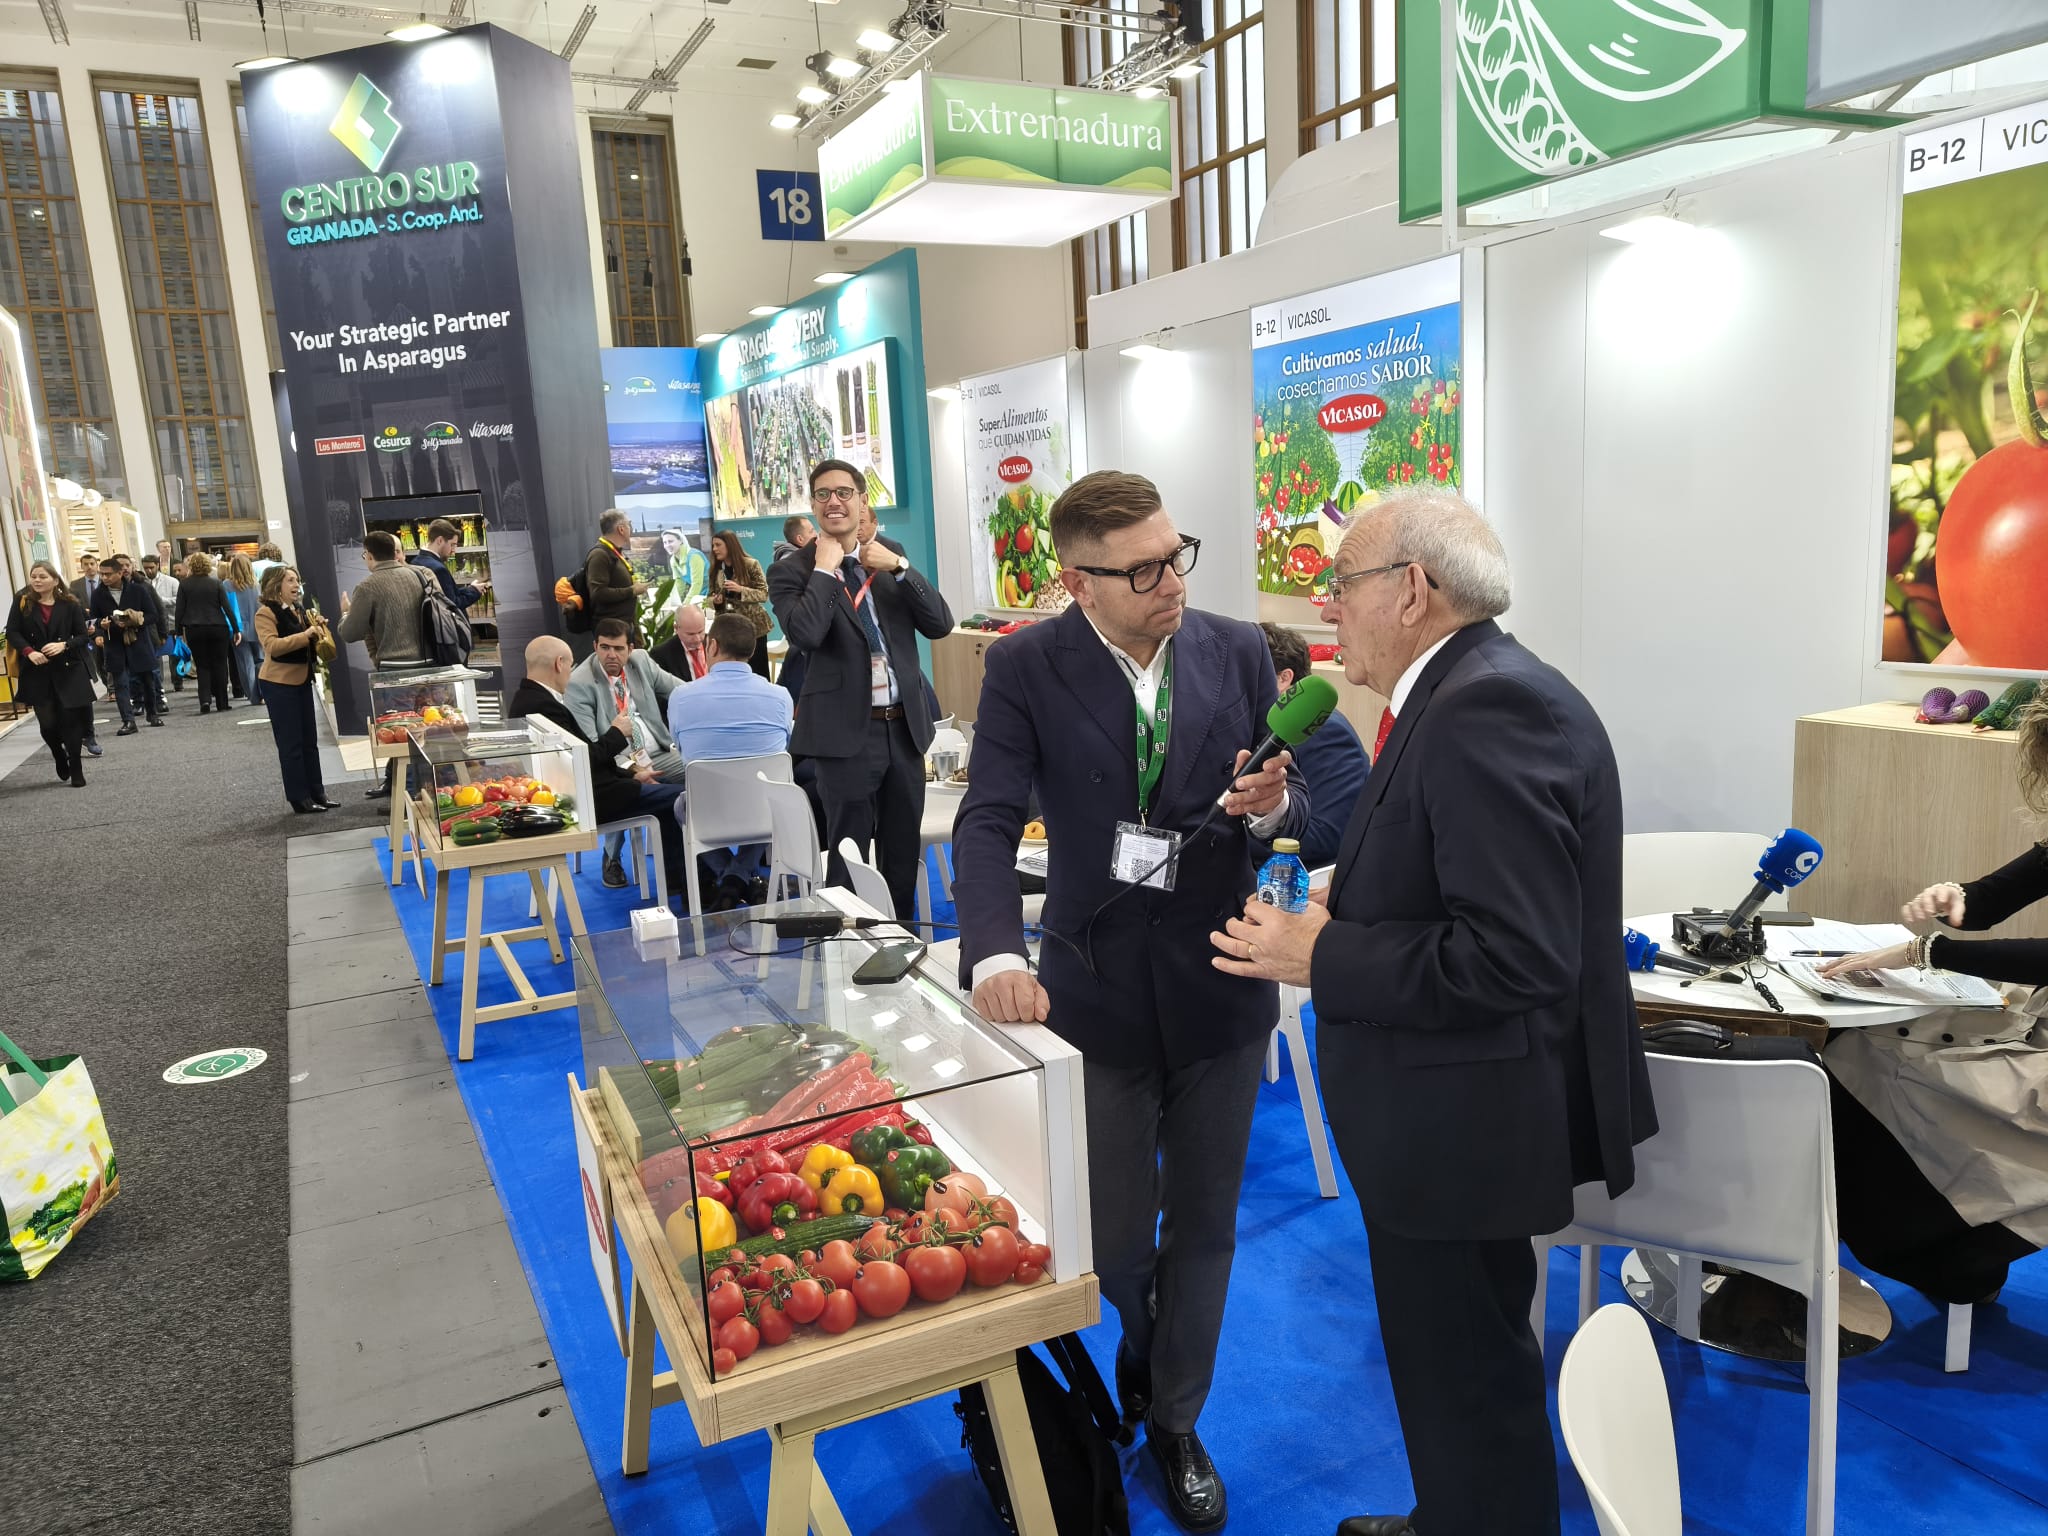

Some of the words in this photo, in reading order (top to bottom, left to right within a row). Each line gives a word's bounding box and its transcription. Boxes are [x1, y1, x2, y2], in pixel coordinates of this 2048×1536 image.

[945, 97, 1162, 151] Extremadura
[1909, 138, 1966, 172] B-12
[281, 172, 411, 222] CENTRO
[415, 161, 480, 203] SUR
[768, 187, 813, 225] 18
[286, 217, 379, 246] GRANADA
[387, 213, 402, 232] S.
[402, 211, 448, 231] Coop.
[449, 202, 484, 222] And.
[290, 330, 334, 351] Your
[339, 317, 429, 346] Strategic
[433, 310, 511, 335] Partner
[1256, 319, 1276, 337] B-12
[1287, 307, 1332, 330] VICASOL
[338, 352, 357, 373] In
[363, 344, 467, 374] Asparagus
[811, 334, 839, 358] Supply.
[1282, 347, 1361, 376] Cultivamos
[1365, 321, 1424, 361] salud,
[977, 383, 1002, 397] VICASOL
[1277, 369, 1367, 401] cosechamos
[1371, 354, 1433, 385] SABOR
[1320, 402, 1383, 426] VICASOL
[374, 436, 412, 448] Cesurca
[469, 421, 514, 438] Vitasana
[978, 439, 993, 450] que
[993, 431, 1025, 448] CUIDAN
[1026, 426, 1052, 442] VIDAS
[999, 462, 1031, 476] VICASOL
